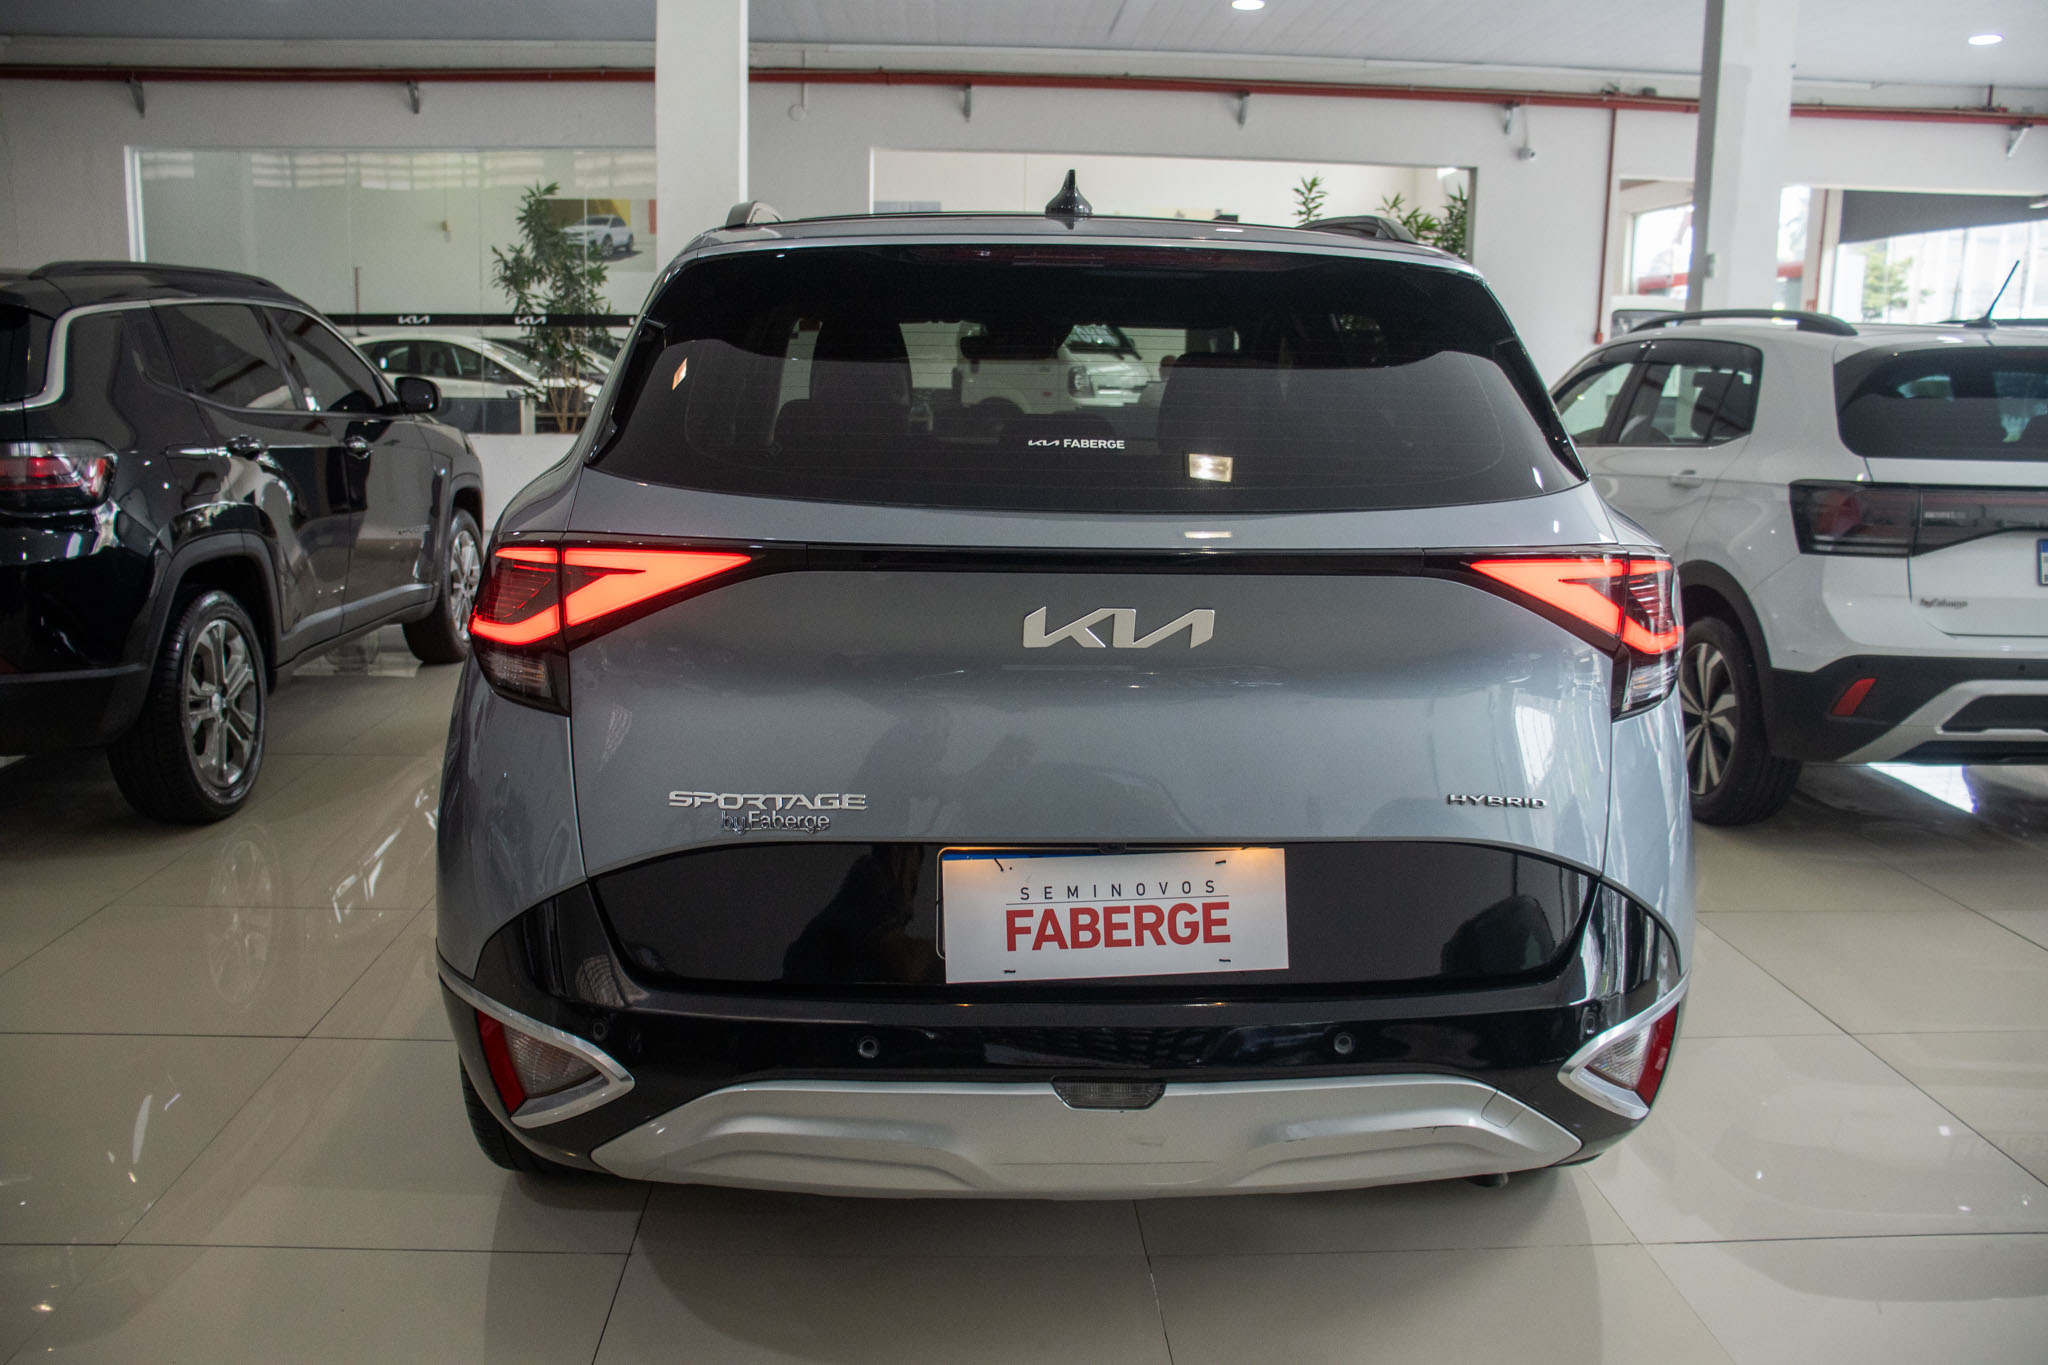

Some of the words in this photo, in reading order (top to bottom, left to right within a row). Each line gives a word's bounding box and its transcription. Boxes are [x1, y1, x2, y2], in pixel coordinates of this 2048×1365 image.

[1063, 438, 1126, 450] FABERGE
[1022, 606, 1215, 649] KIA
[668, 790, 868, 812] SPORTAGE
[1446, 794, 1547, 809] HYBRID
[747, 810, 831, 834] Faberge
[1020, 879, 1216, 901] SEMINOVOS
[1005, 902, 1231, 952] FABERGE
